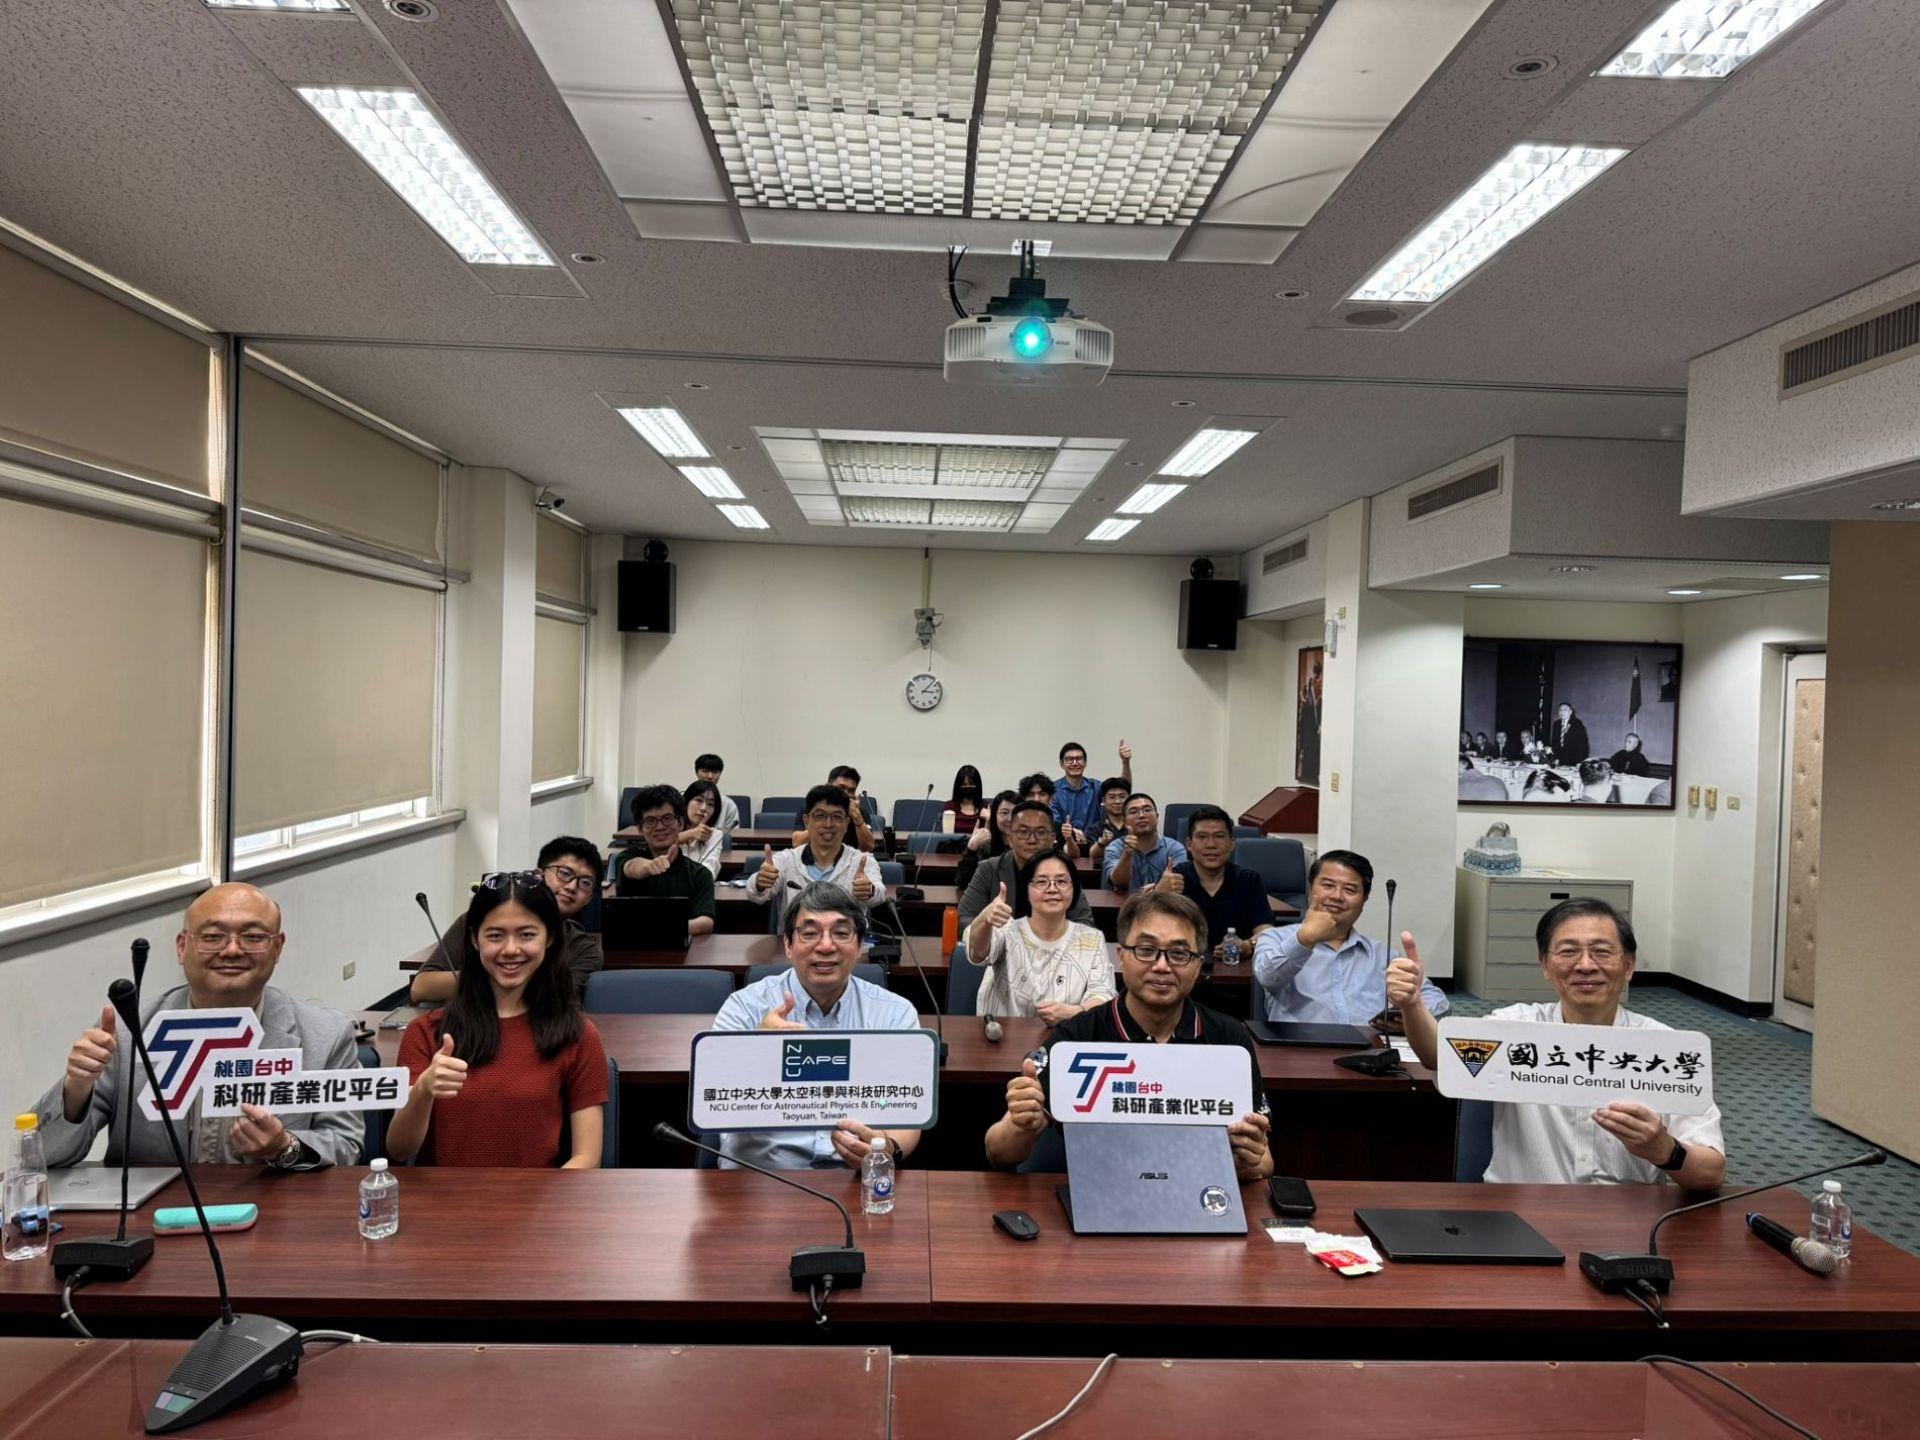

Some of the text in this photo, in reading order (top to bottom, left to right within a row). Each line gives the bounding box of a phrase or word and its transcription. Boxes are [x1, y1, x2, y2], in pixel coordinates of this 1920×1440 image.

[214, 1058, 293, 1078] 桃園台中
[1507, 1043, 1705, 1080] 國立中央大學
[213, 1076, 398, 1108] 科研產業化平台
[703, 1085, 924, 1101] 國立中央大學太空科學與科技研究中心
[1511, 1071, 1703, 1097] National Central University
[709, 1100, 917, 1112] NCU Center for Astronautical Physics & Engineering
[1112, 1097, 1234, 1115] 科研產業化平台
[782, 1112, 847, 1122] Taoyuan, Taiwan
[1139, 1172, 1169, 1180] ASUS
